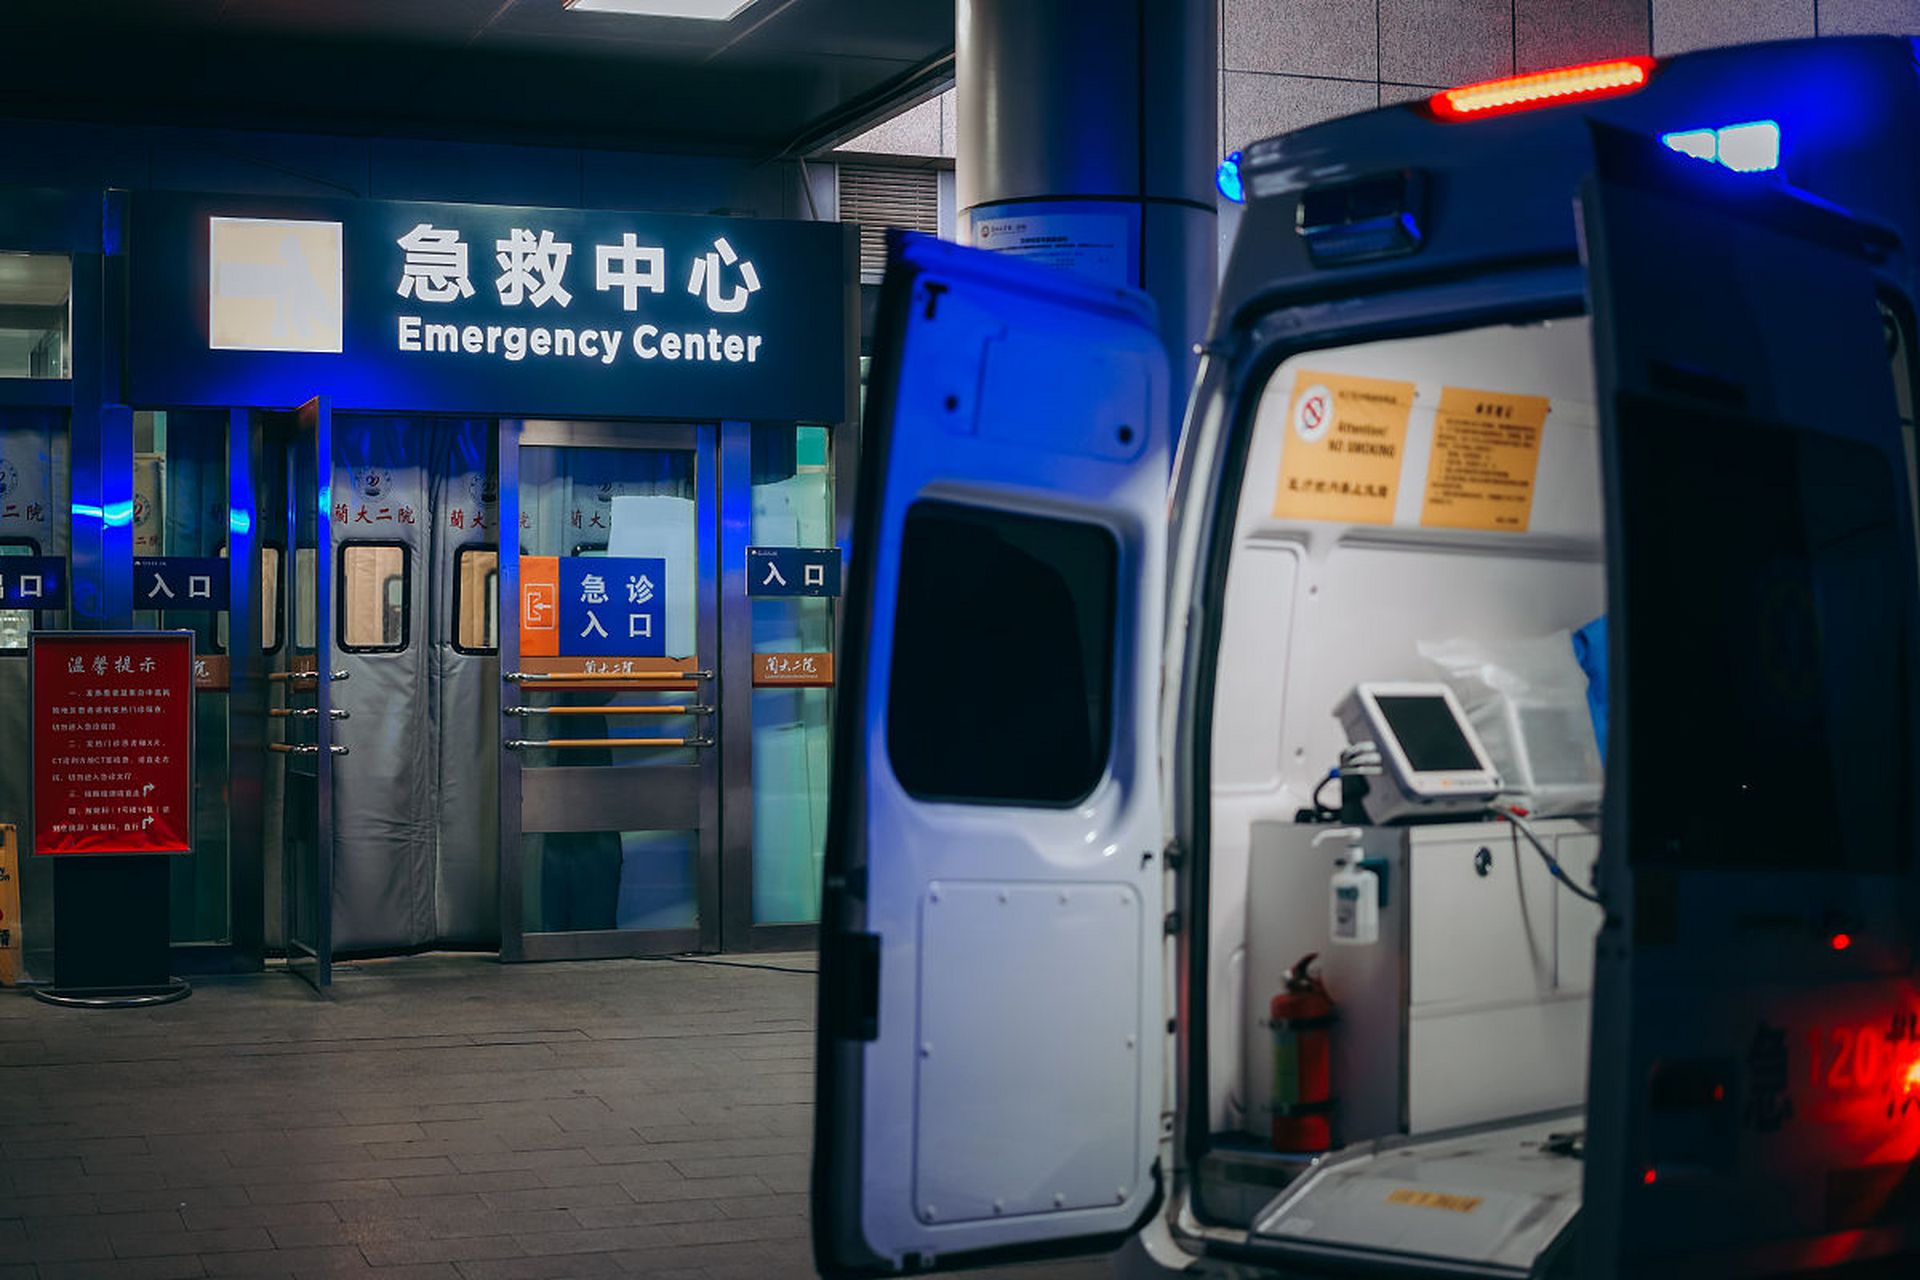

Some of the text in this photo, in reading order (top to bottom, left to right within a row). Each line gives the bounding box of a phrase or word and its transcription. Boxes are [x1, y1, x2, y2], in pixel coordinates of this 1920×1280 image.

[395, 223, 763, 314] 急救中心
[397, 315, 764, 364] Emergency Center
[0, 573, 43, 600] 口
[148, 572, 212, 600] 入口
[579, 572, 655, 606] 急诊
[762, 561, 825, 587] 入口
[579, 610, 653, 640] 入口
[67, 655, 158, 677] 温馨提示
[1808, 1023, 1881, 1090] 120
